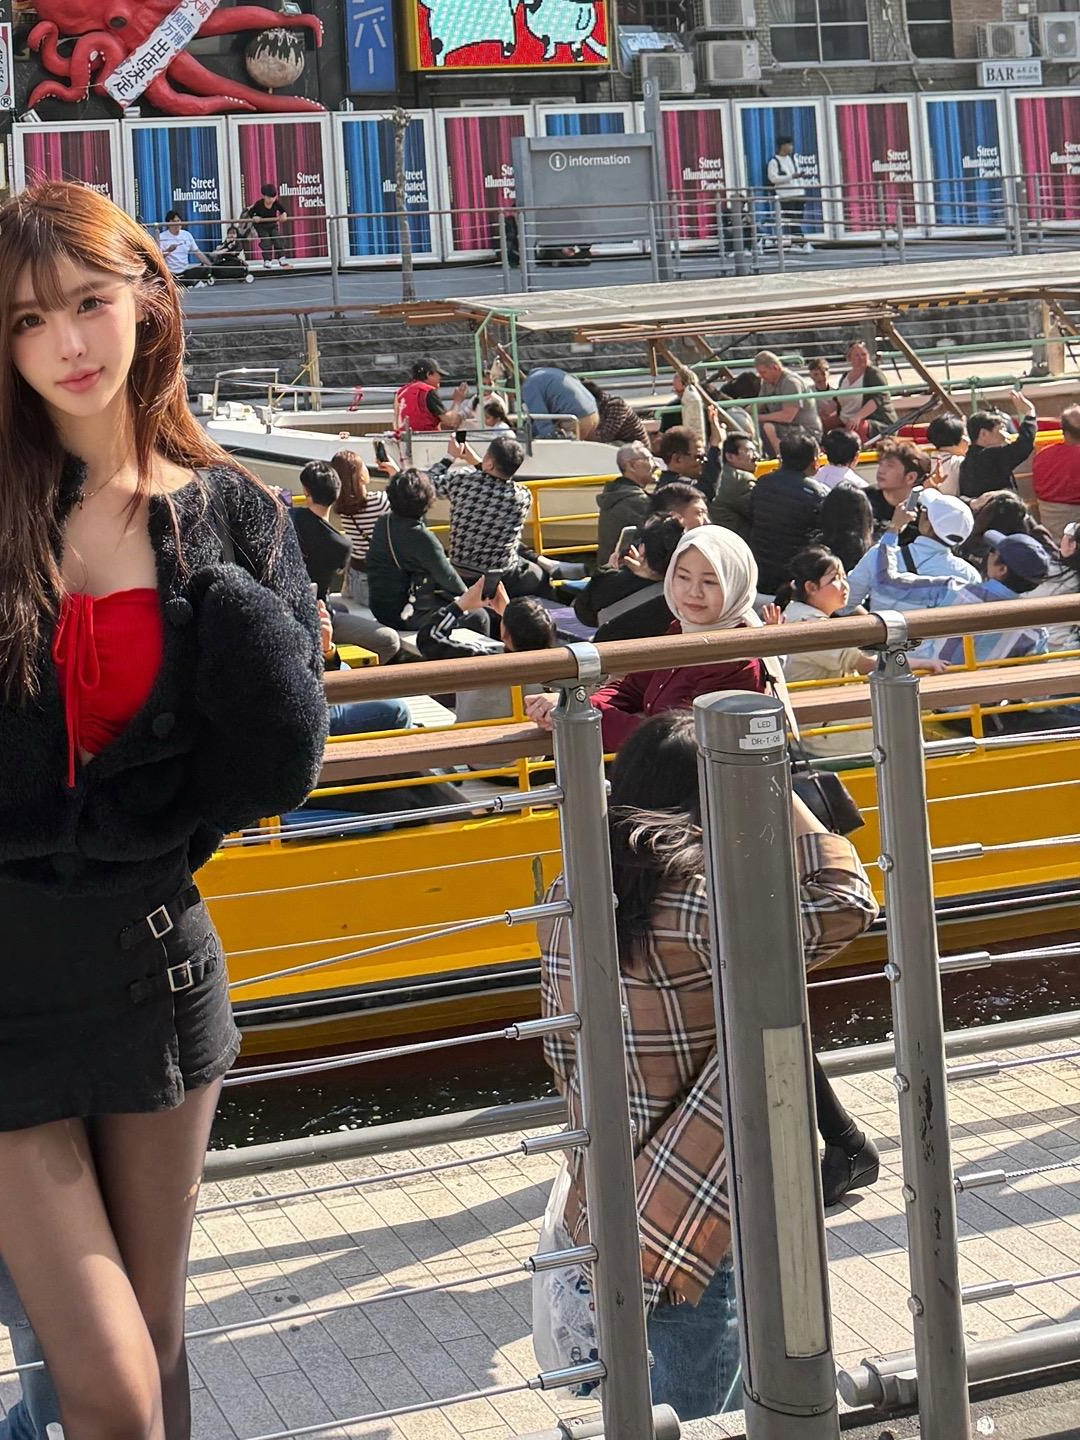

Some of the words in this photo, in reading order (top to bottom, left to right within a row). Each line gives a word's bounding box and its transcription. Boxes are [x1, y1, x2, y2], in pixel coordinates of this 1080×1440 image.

[113, 38, 171, 97] 出店決定
[986, 66, 1015, 81] BAR
[887, 149, 909, 161] Street
[976, 145, 998, 157] Street
[569, 154, 631, 167] information
[699, 156, 721, 169] Street
[296, 172, 321, 184] Street
[404, 169, 423, 180] treet
[191, 176, 216, 189] Street
[173, 188, 218, 201] Illuminated
[279, 183, 323, 197] Illuminated
[757, 721, 771, 729] LED
